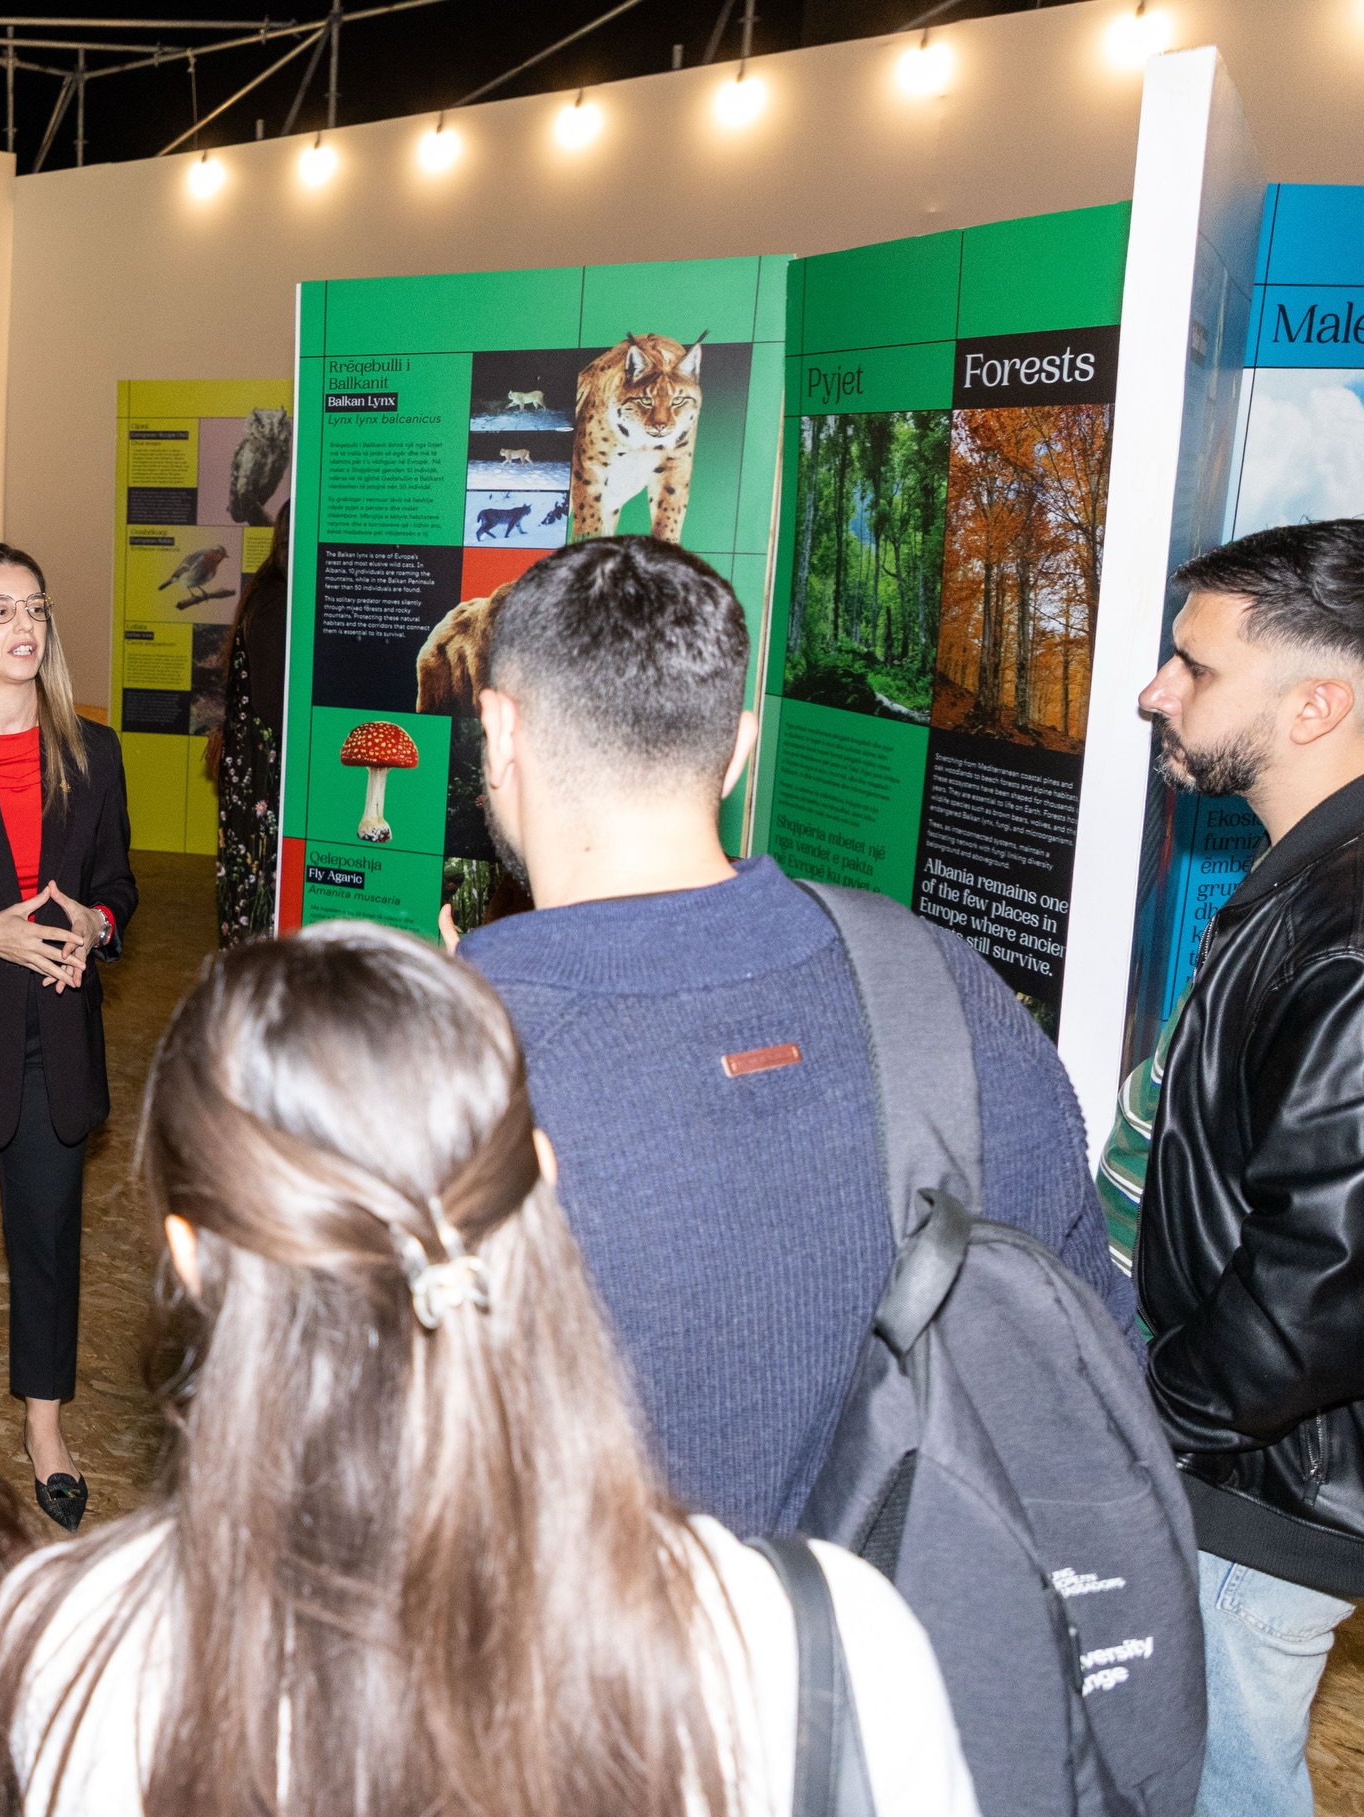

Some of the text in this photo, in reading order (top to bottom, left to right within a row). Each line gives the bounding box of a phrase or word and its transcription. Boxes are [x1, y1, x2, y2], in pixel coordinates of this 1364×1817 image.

[329, 358, 410, 376] Rrëqebulli i
[963, 346, 1095, 388] Forests
[329, 376, 388, 390] Ballkanit
[808, 364, 863, 404] Pyjet
[328, 396, 395, 408] Balkan Lynx
[328, 414, 441, 427] Lynx lynx balcanicus
[326, 550, 335, 558] The
[356, 551, 367, 560] lynx
[396, 570, 419, 578] roaming
[407, 577, 435, 585] Peninsula
[325, 582, 339, 590] fewer
[354, 583, 361, 591] 50
[363, 584, 391, 592] individuals
[324, 603, 344, 612] through
[395, 607, 411, 615] rocky
[336, 596, 354, 605] solitary
[356, 597, 379, 605] predator
[401, 598, 422, 607] silently
[323, 619, 344, 627] habitats
[393, 622, 405, 630] that
[353, 612, 382, 622] Protecting
[343, 628, 366, 636] essential
[777, 814, 885, 862] Shqipëria mbetet një
[1204, 832, 1260, 852] furniz
[309, 851, 382, 871] Qeleposhja
[775, 834, 873, 876] nga vendet e pakta
[788, 854, 824, 878] Evropë
[827, 865, 840, 884] ku
[1200, 855, 1252, 874] ëmbë
[309, 868, 363, 884] Fly Agaric
[924, 858, 1069, 914] Albania remains one
[308, 885, 401, 906] Amanita muscaria
[922, 879, 1057, 933] of the few places in
[1195, 902, 1218, 920] dh
[920, 897, 967, 925] Europe
[971, 916, 1016, 941] where
[1020, 932, 1066, 958] ancie
[966, 935, 1053, 977] still survive.
[1080, 1636, 1154, 1669] versity
